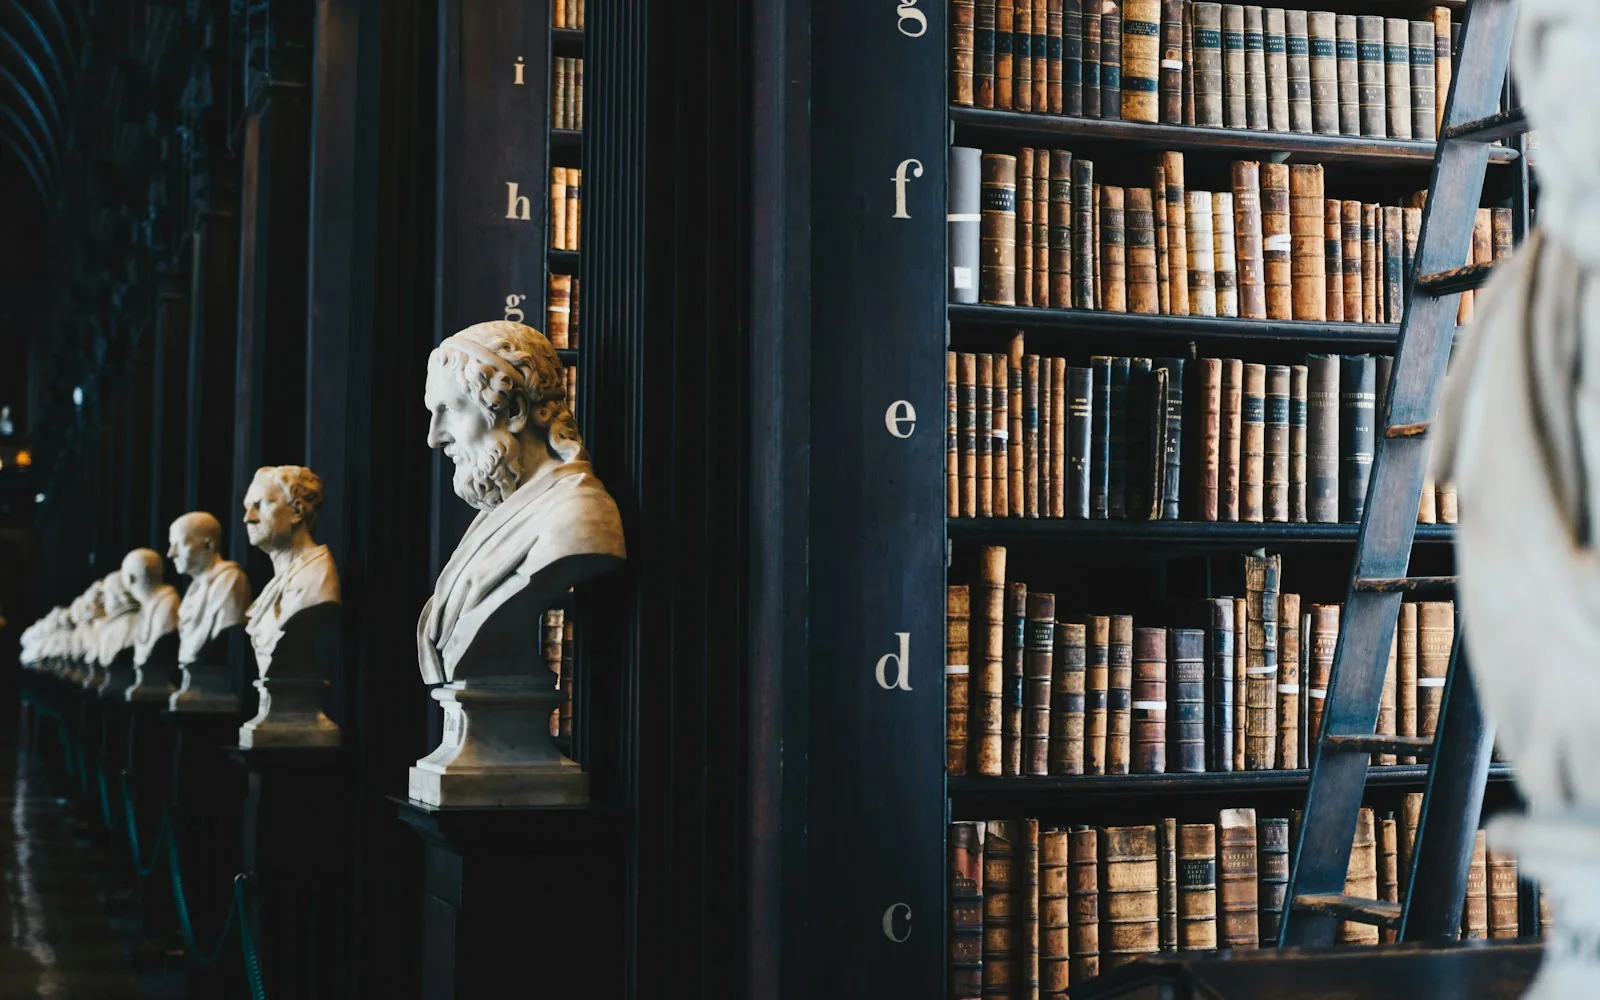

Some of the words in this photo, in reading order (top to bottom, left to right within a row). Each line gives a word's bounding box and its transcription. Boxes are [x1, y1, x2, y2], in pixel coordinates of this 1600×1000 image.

[897, 0, 928, 38] g
[513, 56, 525, 85] i
[505, 182, 531, 221] h
[890, 158, 924, 219] f
[504, 294, 527, 322] g
[885, 400, 917, 439] e
[875, 632, 913, 691] d
[882, 902, 912, 943] c
